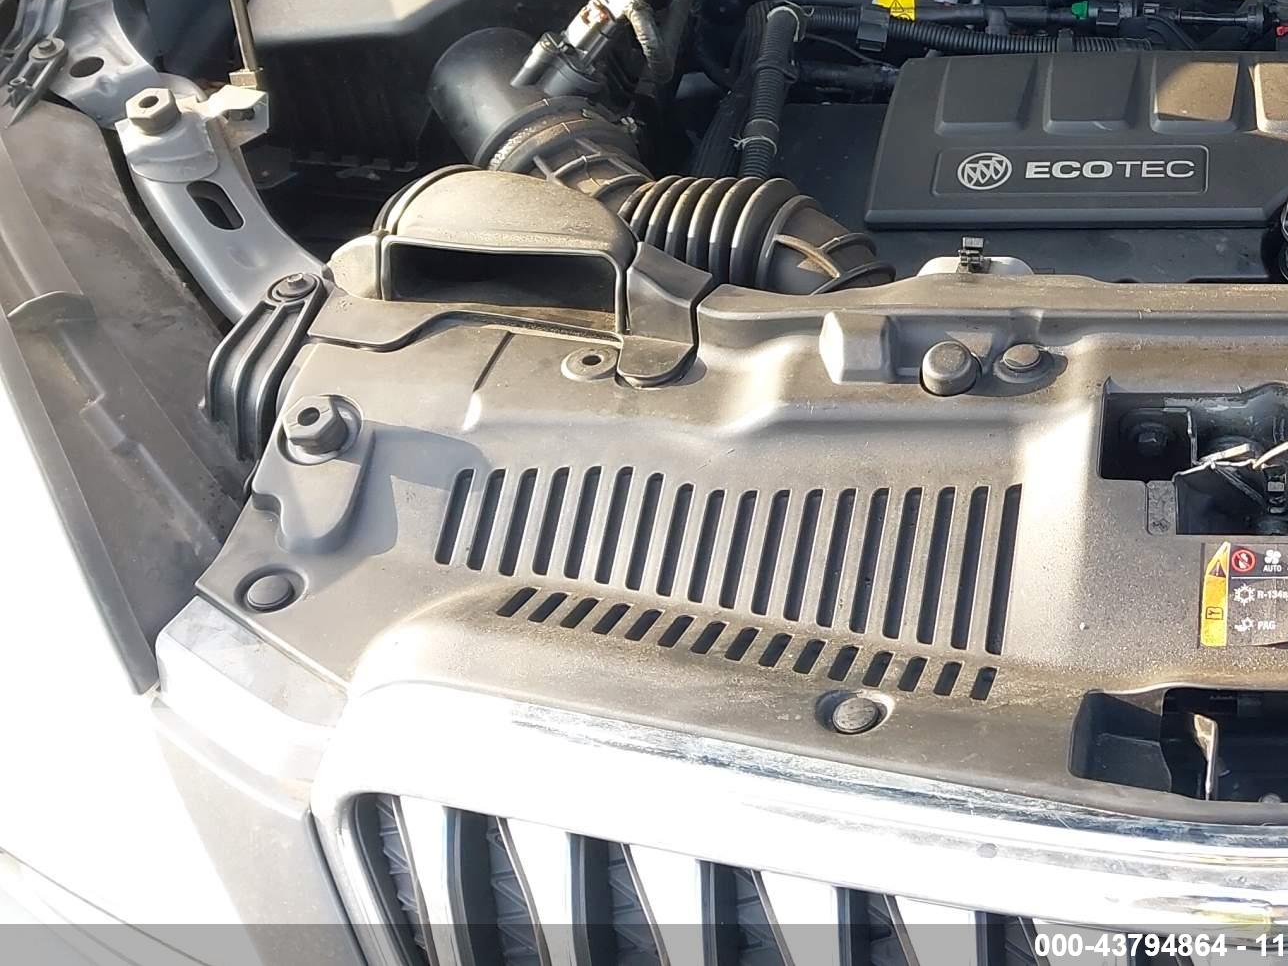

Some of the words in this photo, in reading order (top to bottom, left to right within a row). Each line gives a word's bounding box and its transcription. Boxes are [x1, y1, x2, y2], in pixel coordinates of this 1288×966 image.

[1025, 160, 1195, 179] ECOTEC
[1262, 564, 1283, 573] AUTO
[1257, 620, 1277, 631] PAG
